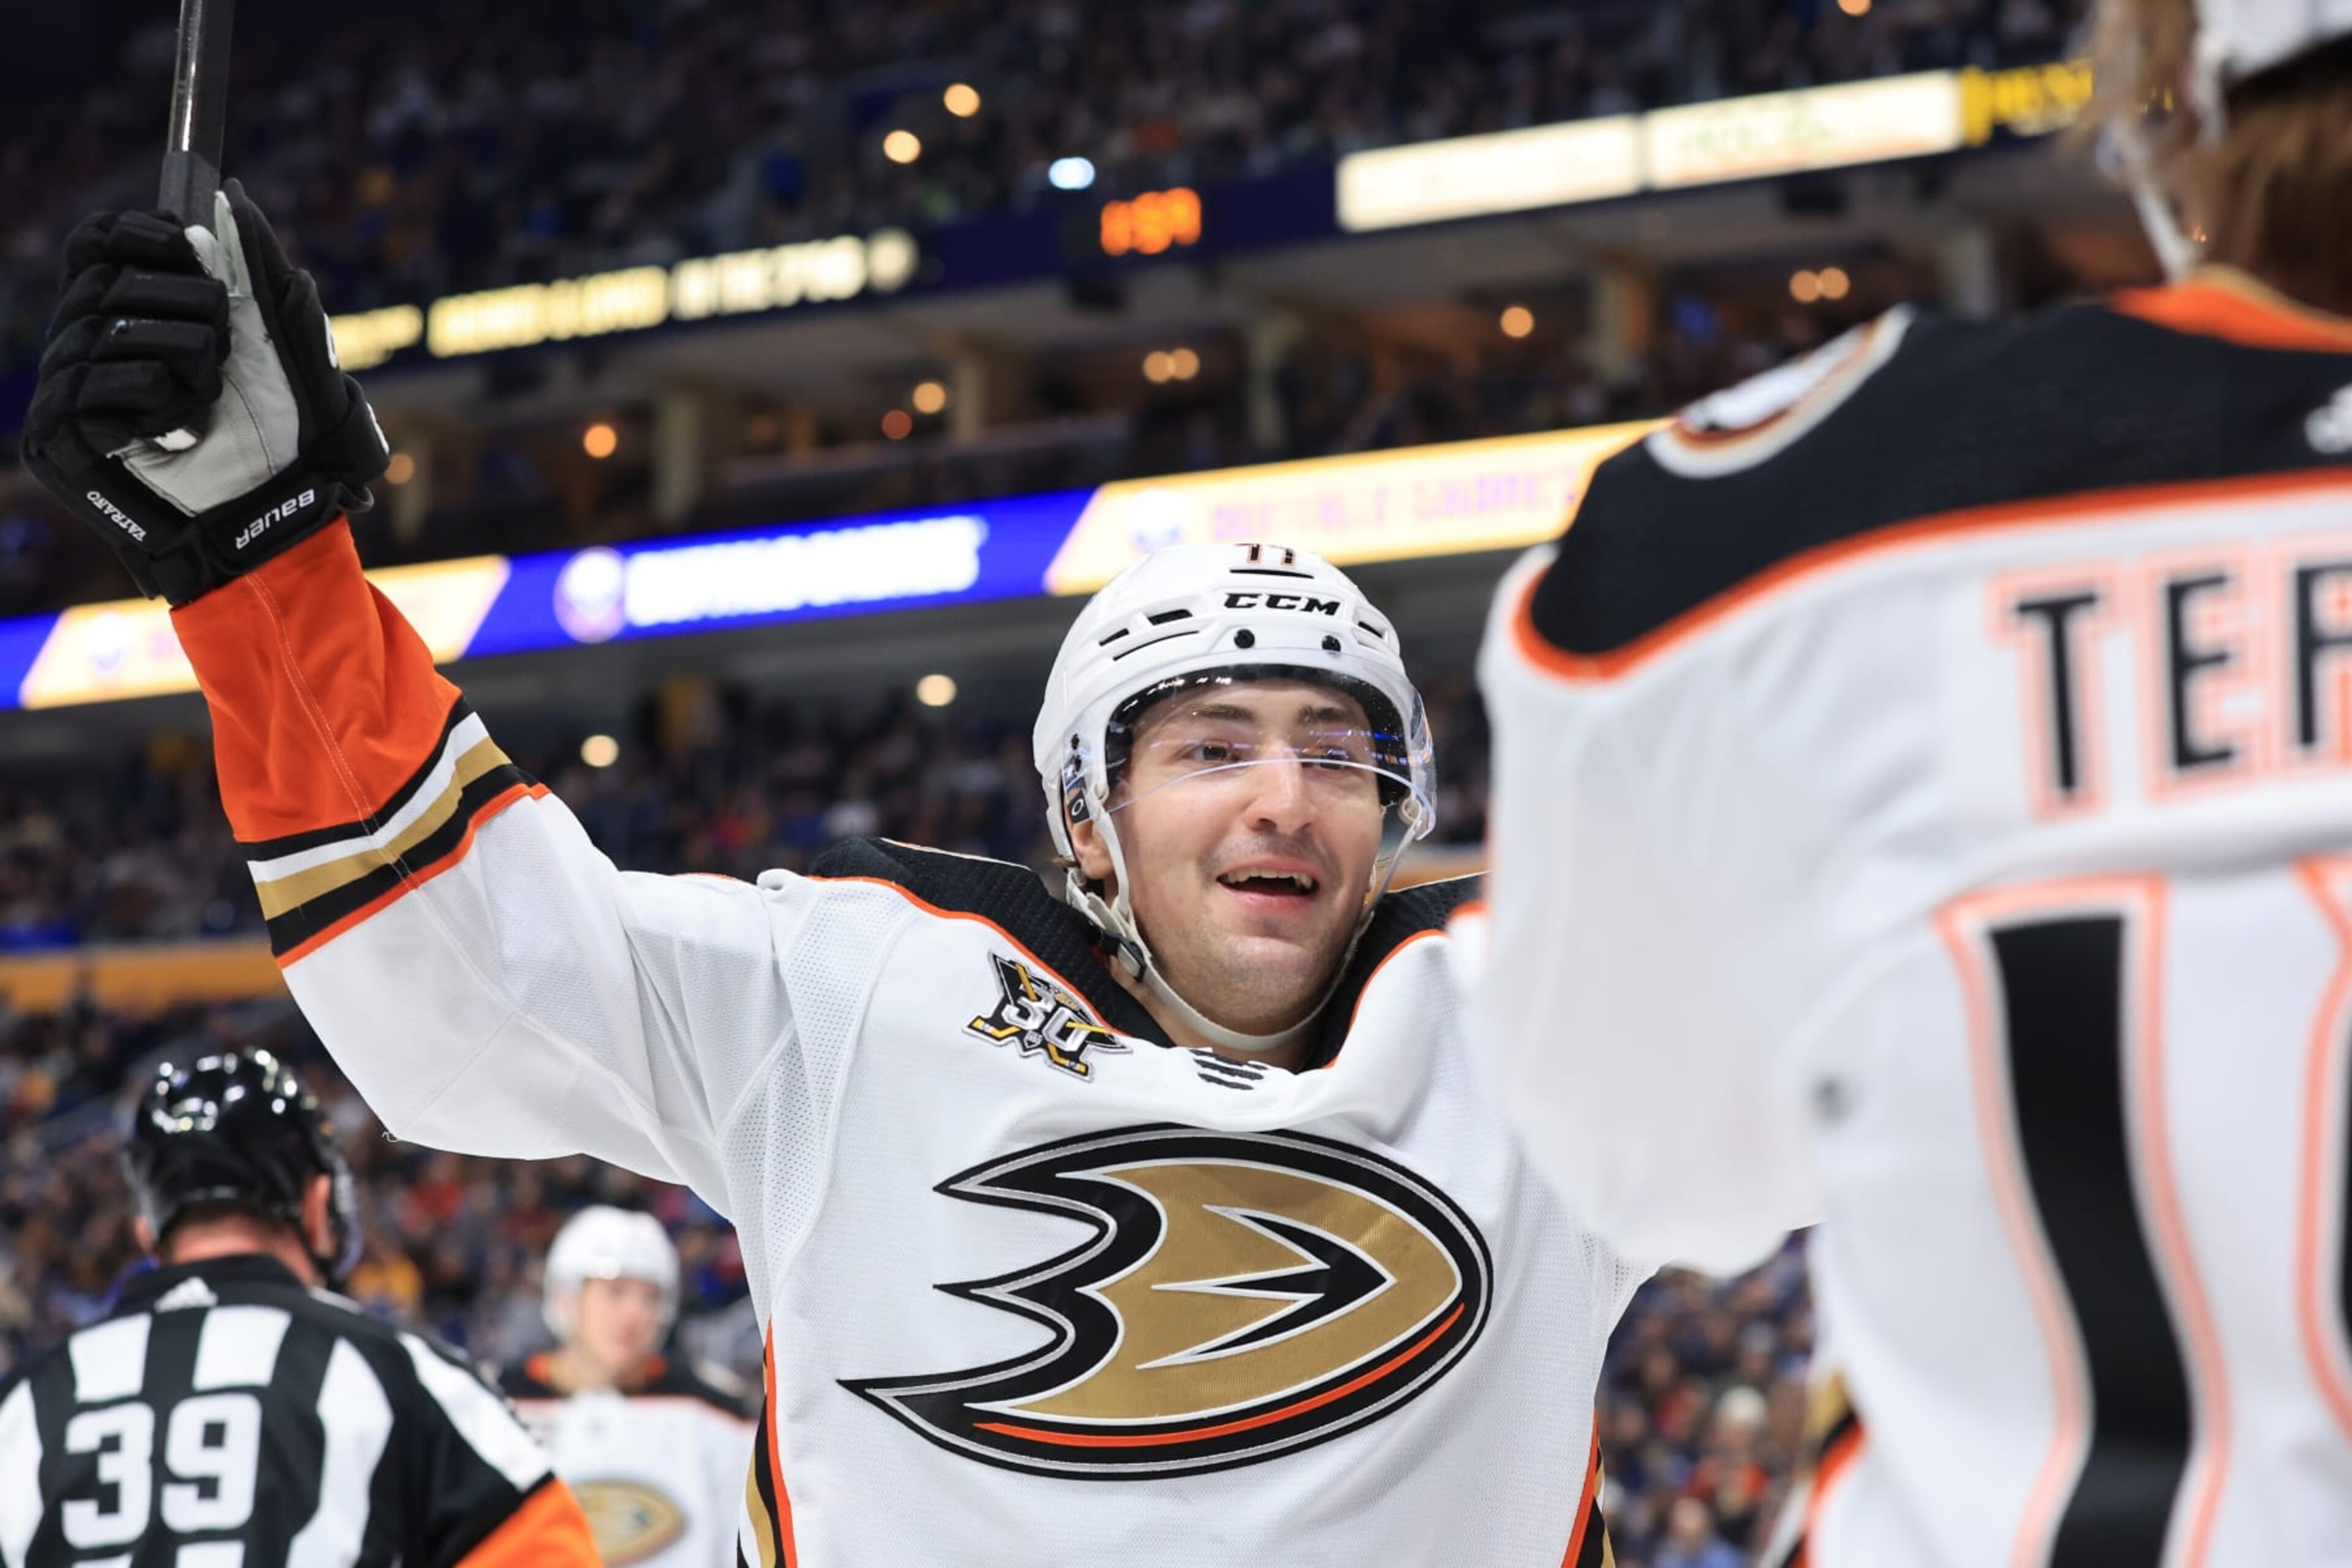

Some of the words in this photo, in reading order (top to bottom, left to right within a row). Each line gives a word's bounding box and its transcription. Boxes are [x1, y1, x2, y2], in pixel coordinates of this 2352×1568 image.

[86, 491, 147, 542] VATRANO
[1224, 592, 1341, 616] CCM
[1001, 982, 1092, 1052] 30
[61, 1392, 263, 1550] 39
